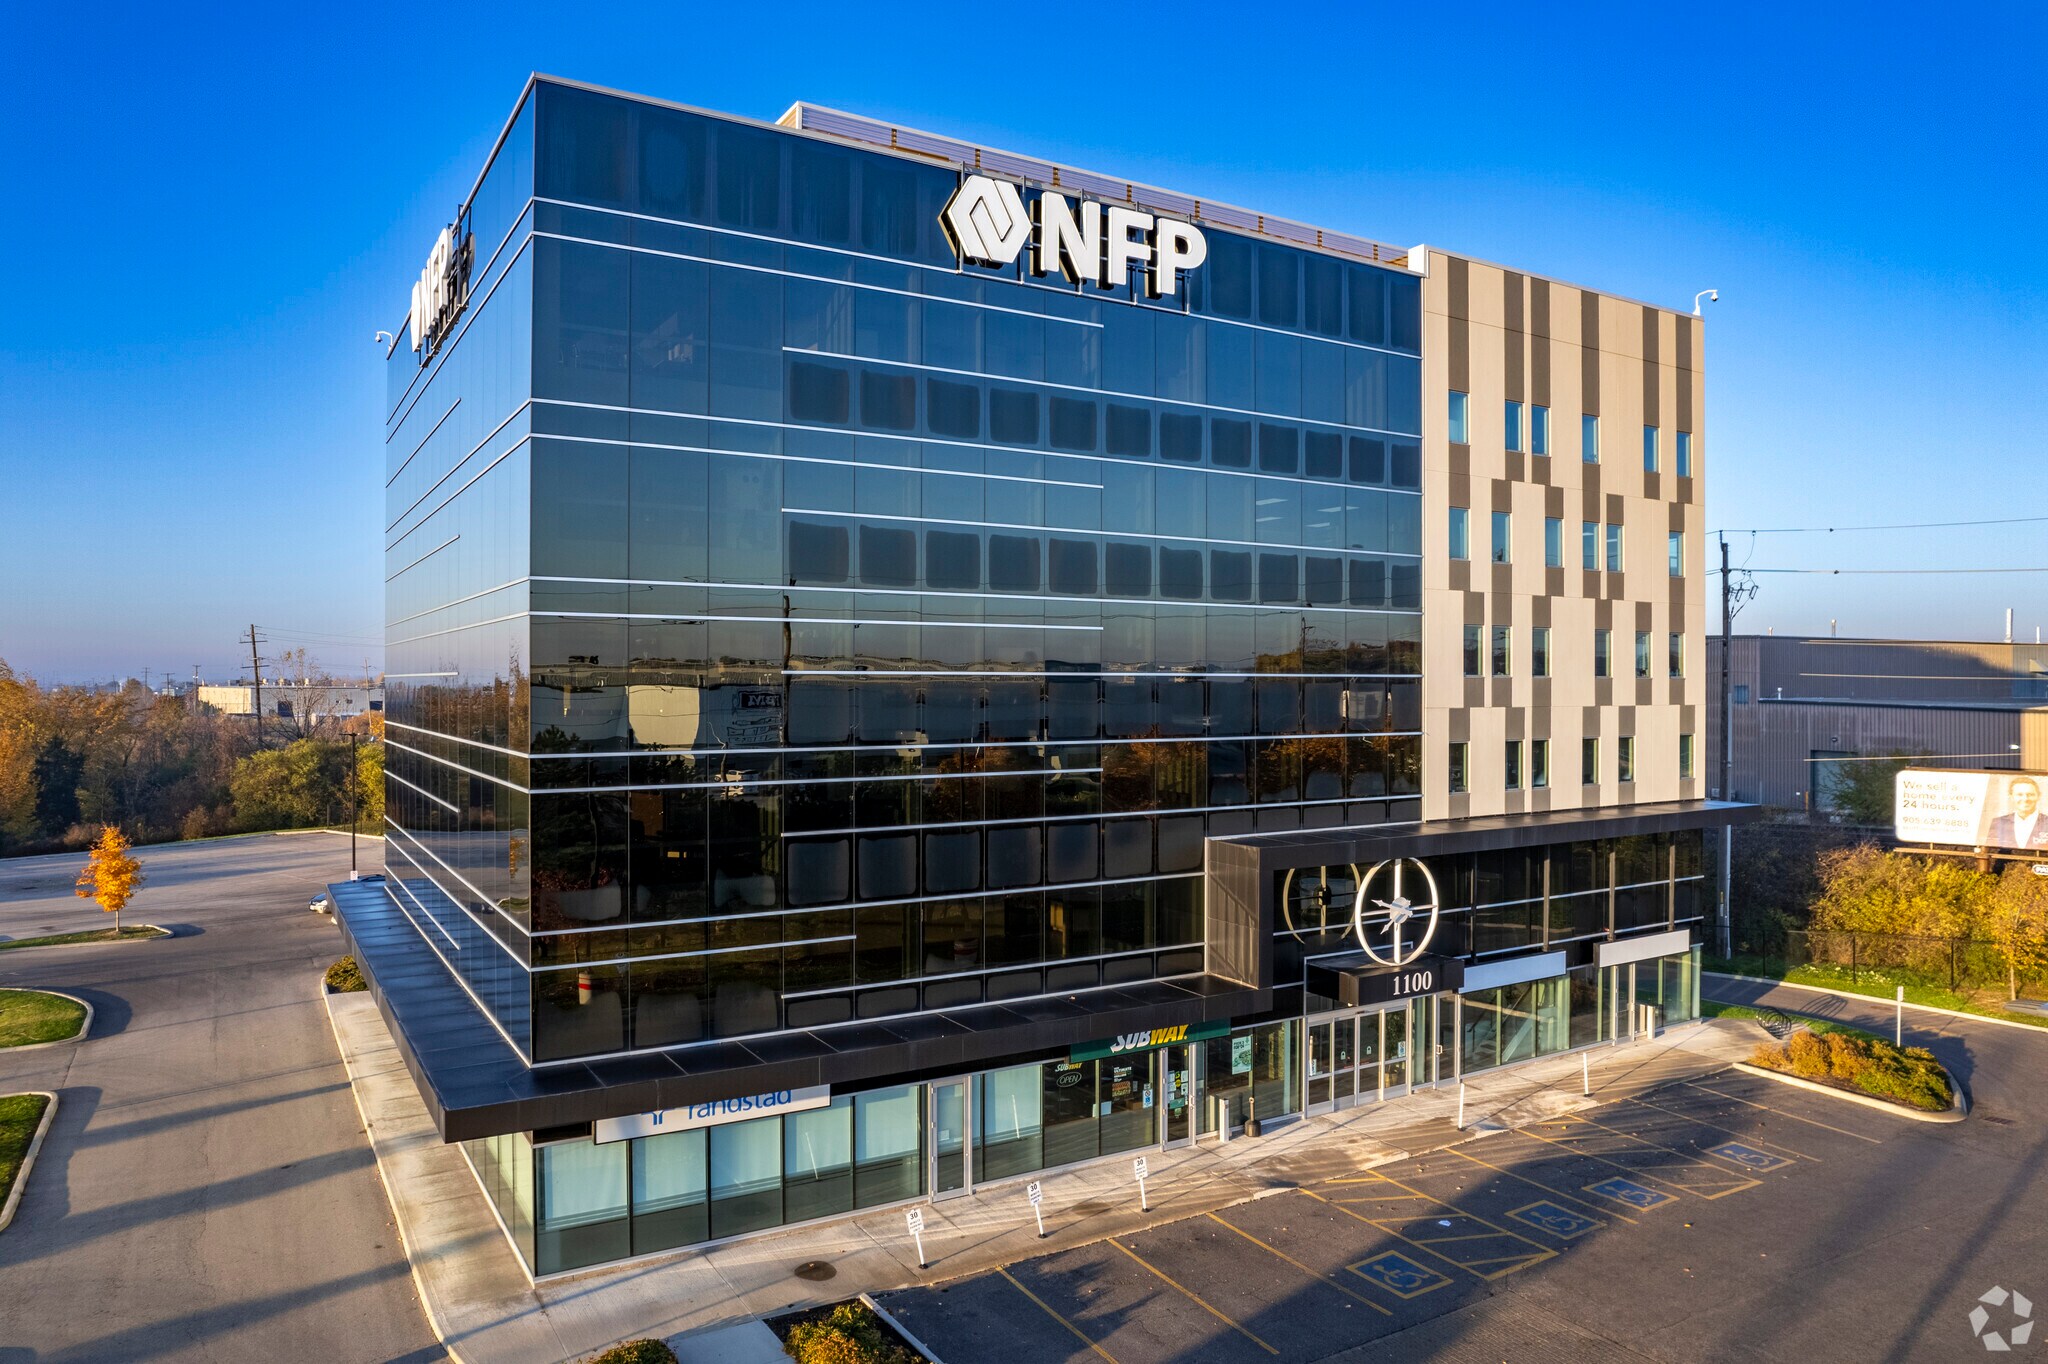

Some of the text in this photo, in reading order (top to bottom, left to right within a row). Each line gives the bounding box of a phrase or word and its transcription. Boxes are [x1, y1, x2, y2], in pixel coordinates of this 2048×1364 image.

[1041, 191, 1207, 295] NFP
[1902, 799, 1918, 808] 24
[1903, 790, 1937, 800] home
[1393, 971, 1432, 995] 1100
[1110, 1024, 1188, 1053] SUBWAY
[1059, 1074, 1079, 1084] OPEN
[688, 1089, 792, 1120] randstad
